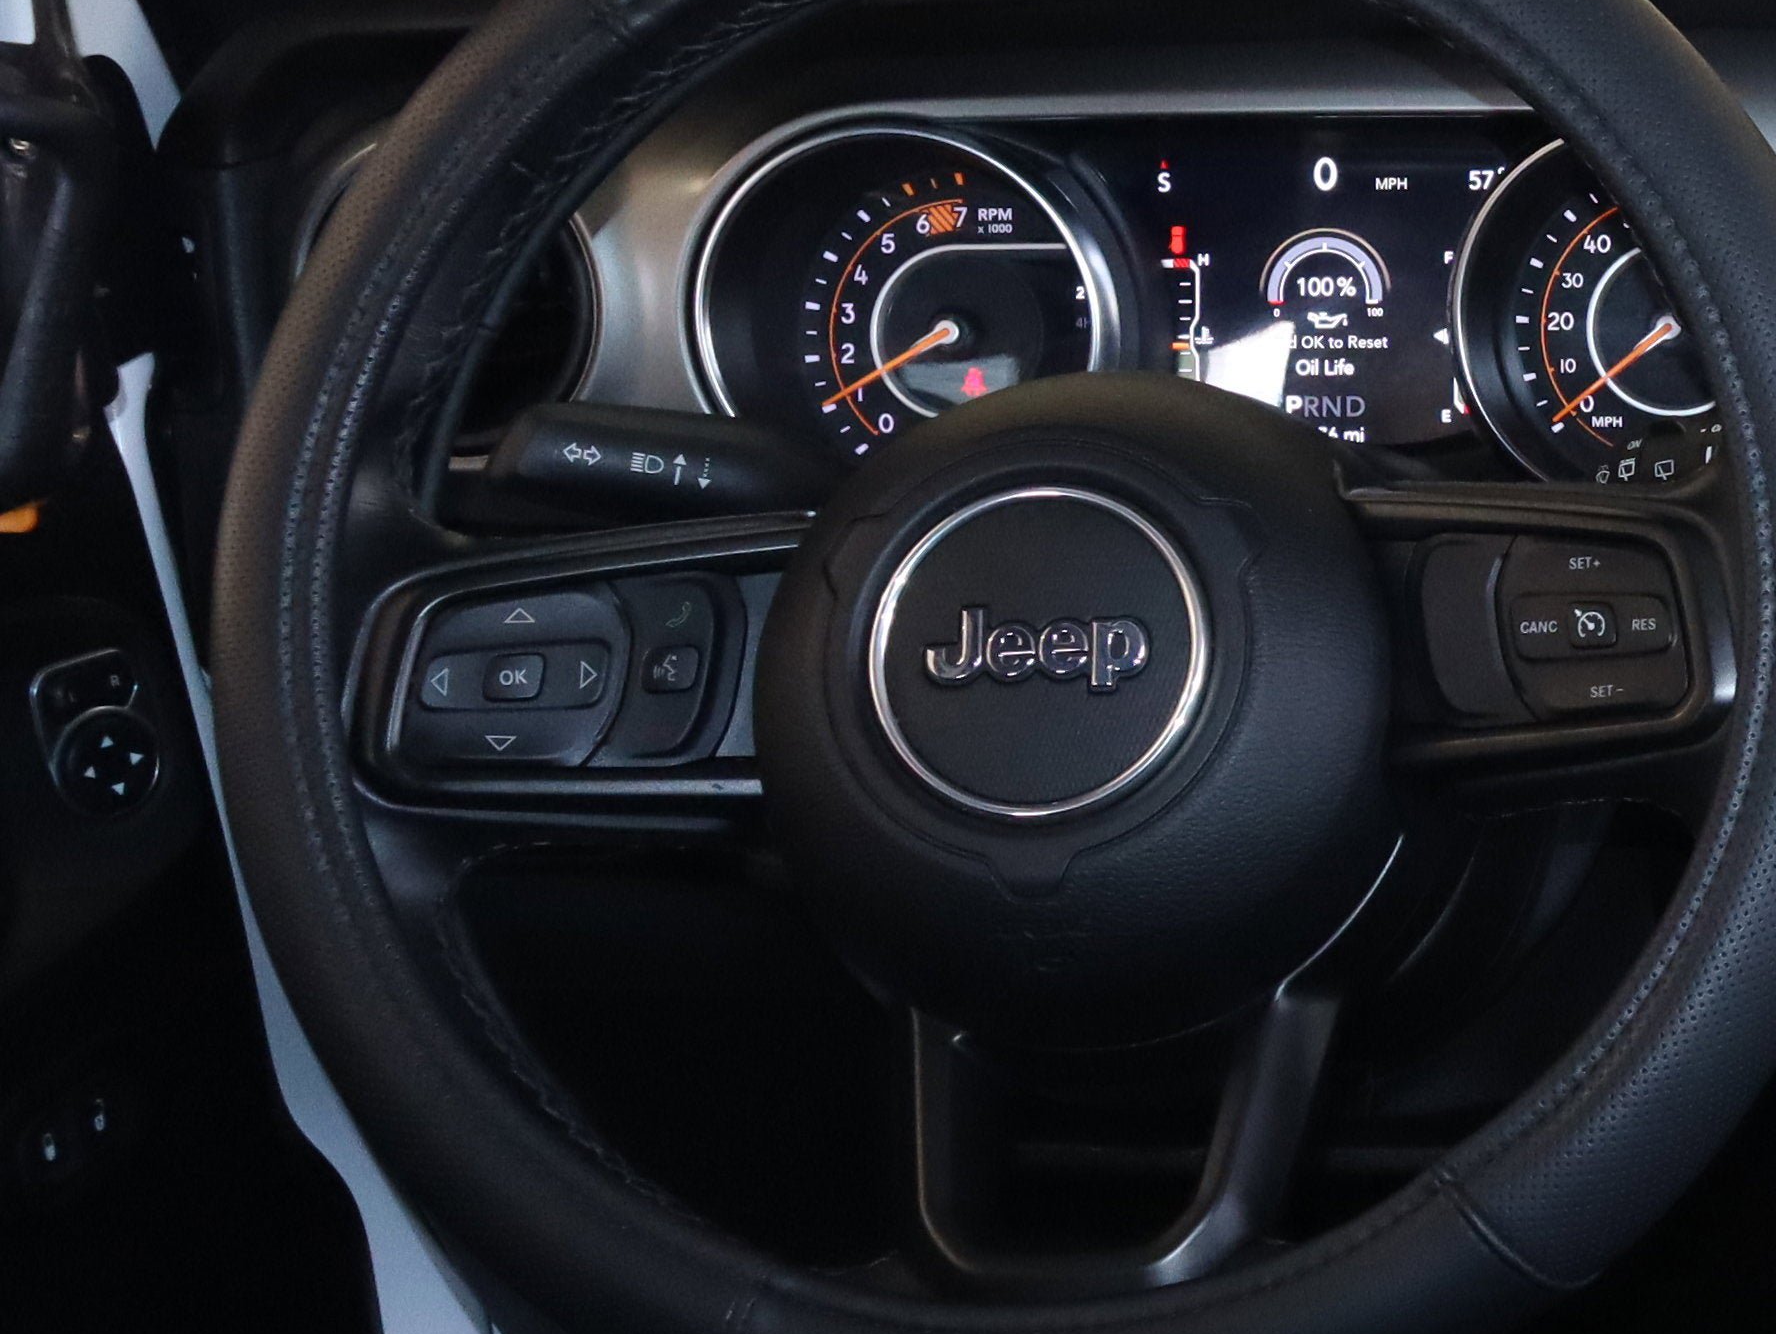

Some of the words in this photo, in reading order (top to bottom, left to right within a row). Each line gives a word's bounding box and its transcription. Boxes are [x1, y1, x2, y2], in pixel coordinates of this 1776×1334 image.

[1157, 171, 1172, 193] S
[1313, 156, 1338, 191] 0
[1375, 177, 1408, 192] MPH
[953, 206, 969, 228] 7
[977, 207, 1013, 222] RPM
[915, 214, 931, 236] 6
[988, 223, 1013, 234] 1000
[880, 233, 896, 254] 5
[1582, 233, 1611, 255] 40
[1197, 253, 1210, 267] H
[853, 264, 869, 286] 4
[1561, 271, 1584, 290] 30
[841, 302, 856, 324] 3
[1366, 308, 1384, 318] 100
[1547, 312, 1575, 331] 20
[1301, 335, 1325, 349] OK
[1328, 335, 1344, 349] to
[1347, 335, 1389, 349] Reset
[841, 343, 856, 364] 2
[1295, 359, 1319, 376] Oil
[1324, 359, 1355, 376] Life
[1560, 357, 1577, 374] 10
[877, 412, 895, 435] 0
[1440, 410, 1452, 424] E
[1591, 416, 1623, 428] MPH
[1520, 620, 1559, 635] CANC
[1631, 618, 1657, 632] RES
[925, 607, 1151, 693] Jeep
[498, 668, 529, 687] OK
